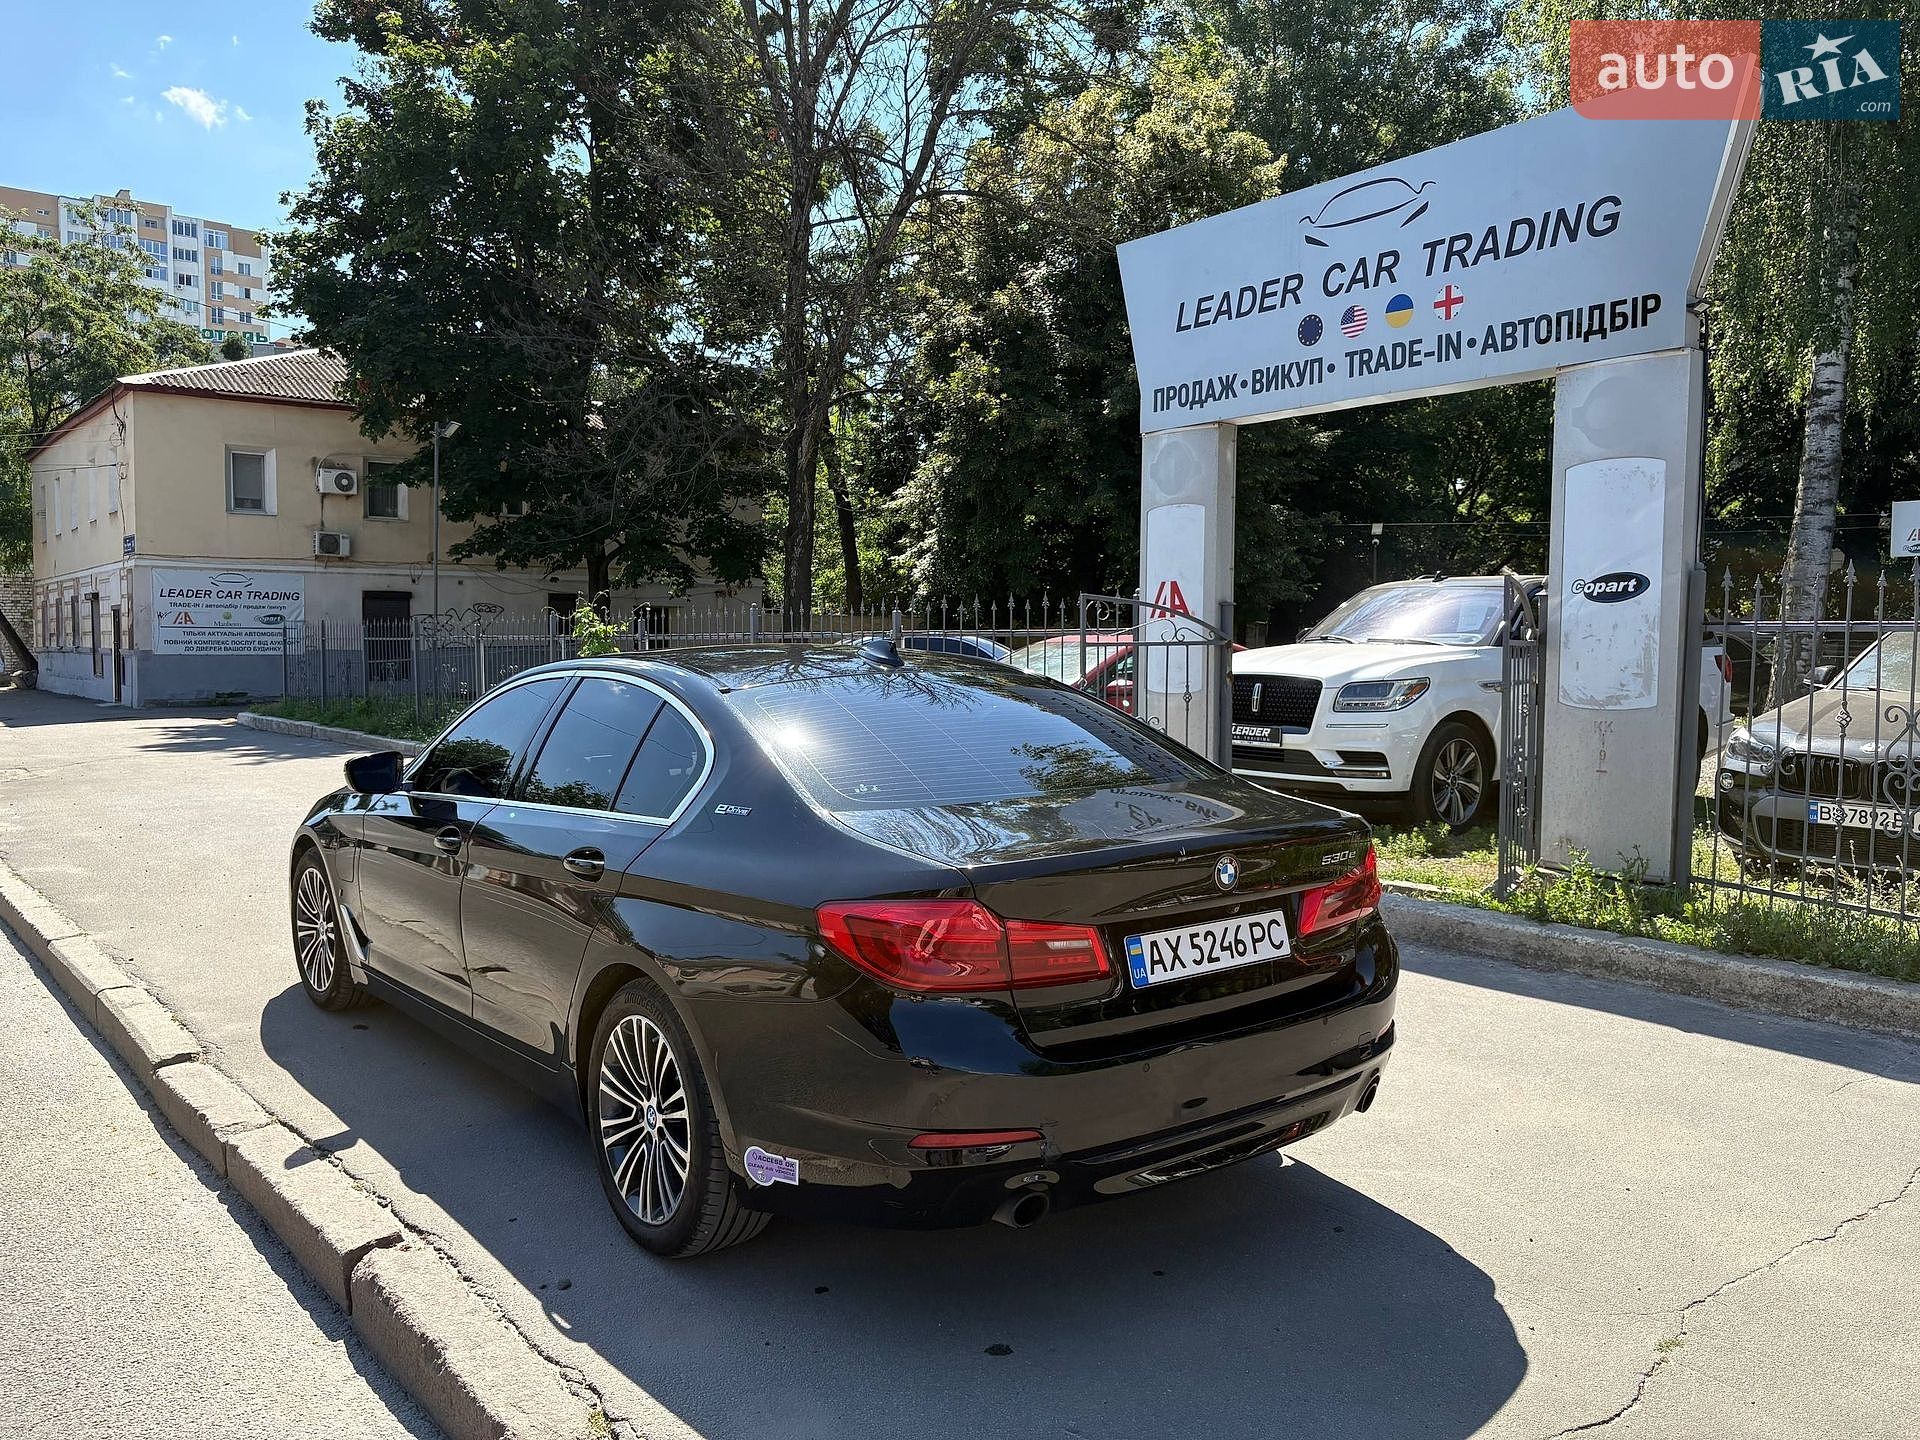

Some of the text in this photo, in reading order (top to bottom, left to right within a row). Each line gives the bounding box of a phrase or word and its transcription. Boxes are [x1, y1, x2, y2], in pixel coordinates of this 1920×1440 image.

[1175, 194, 1623, 333] LEADER CAR TRADING
[1152, 293, 1663, 413] ПРОДАЖ ВИКУП TRADE-IN АВТОПІДБІР
[159, 588, 300, 601] LEADER CAR TRADING
[1571, 578, 1637, 597] Copart
[1231, 725, 1271, 737] LEADER
[1321, 850, 1356, 866] 530e
[1149, 918, 1285, 976] AX 5246 PC
[1133, 968, 1147, 980] UA
[757, 1155, 795, 1169] ACCESS OK
